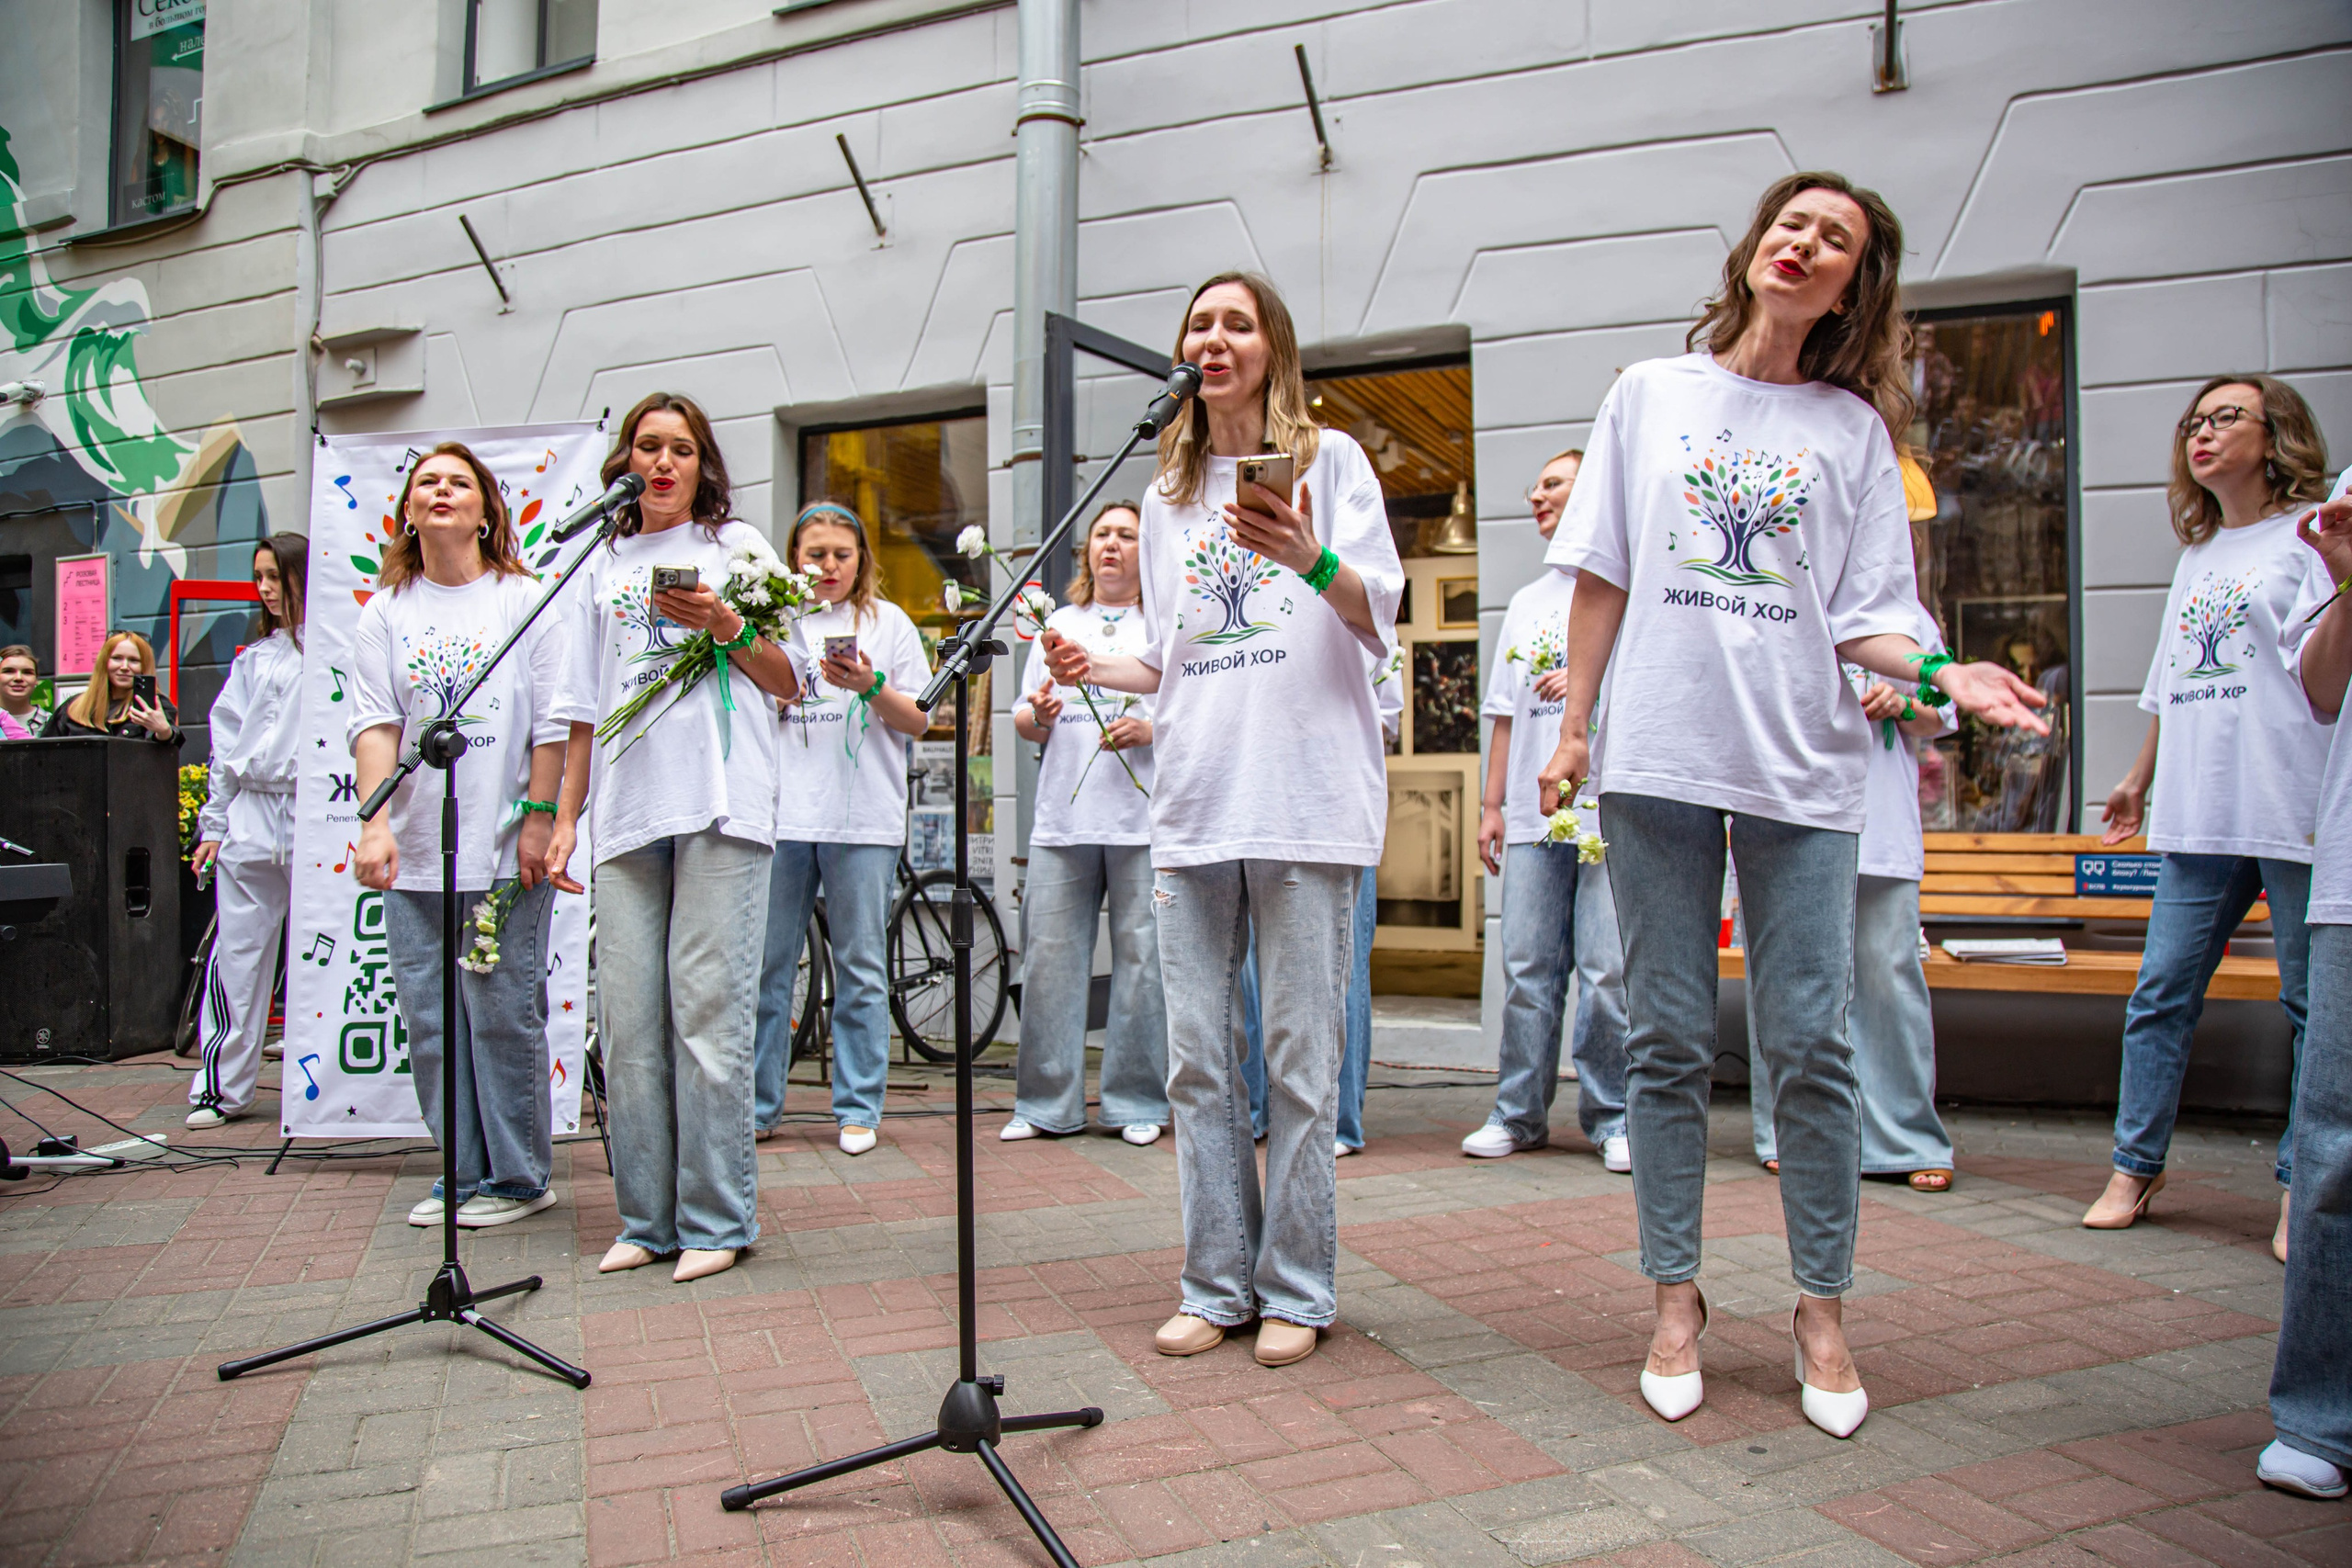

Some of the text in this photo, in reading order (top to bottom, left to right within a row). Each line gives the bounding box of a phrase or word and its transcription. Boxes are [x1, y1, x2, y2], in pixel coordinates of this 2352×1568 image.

[155, 9, 194, 28] большом
[131, 191, 165, 209] кастом
[1663, 588, 1797, 624] ЖИВОЙ ХОР
[1182, 649, 1286, 677] ЖИВОЙ ХОР
[621, 664, 670, 694] ЖИВОЙ
[2170, 684, 2247, 705] ЖИВОЙ ХОР
[820, 712, 842, 723] ХОР
[465, 736, 496, 748] ХОР
